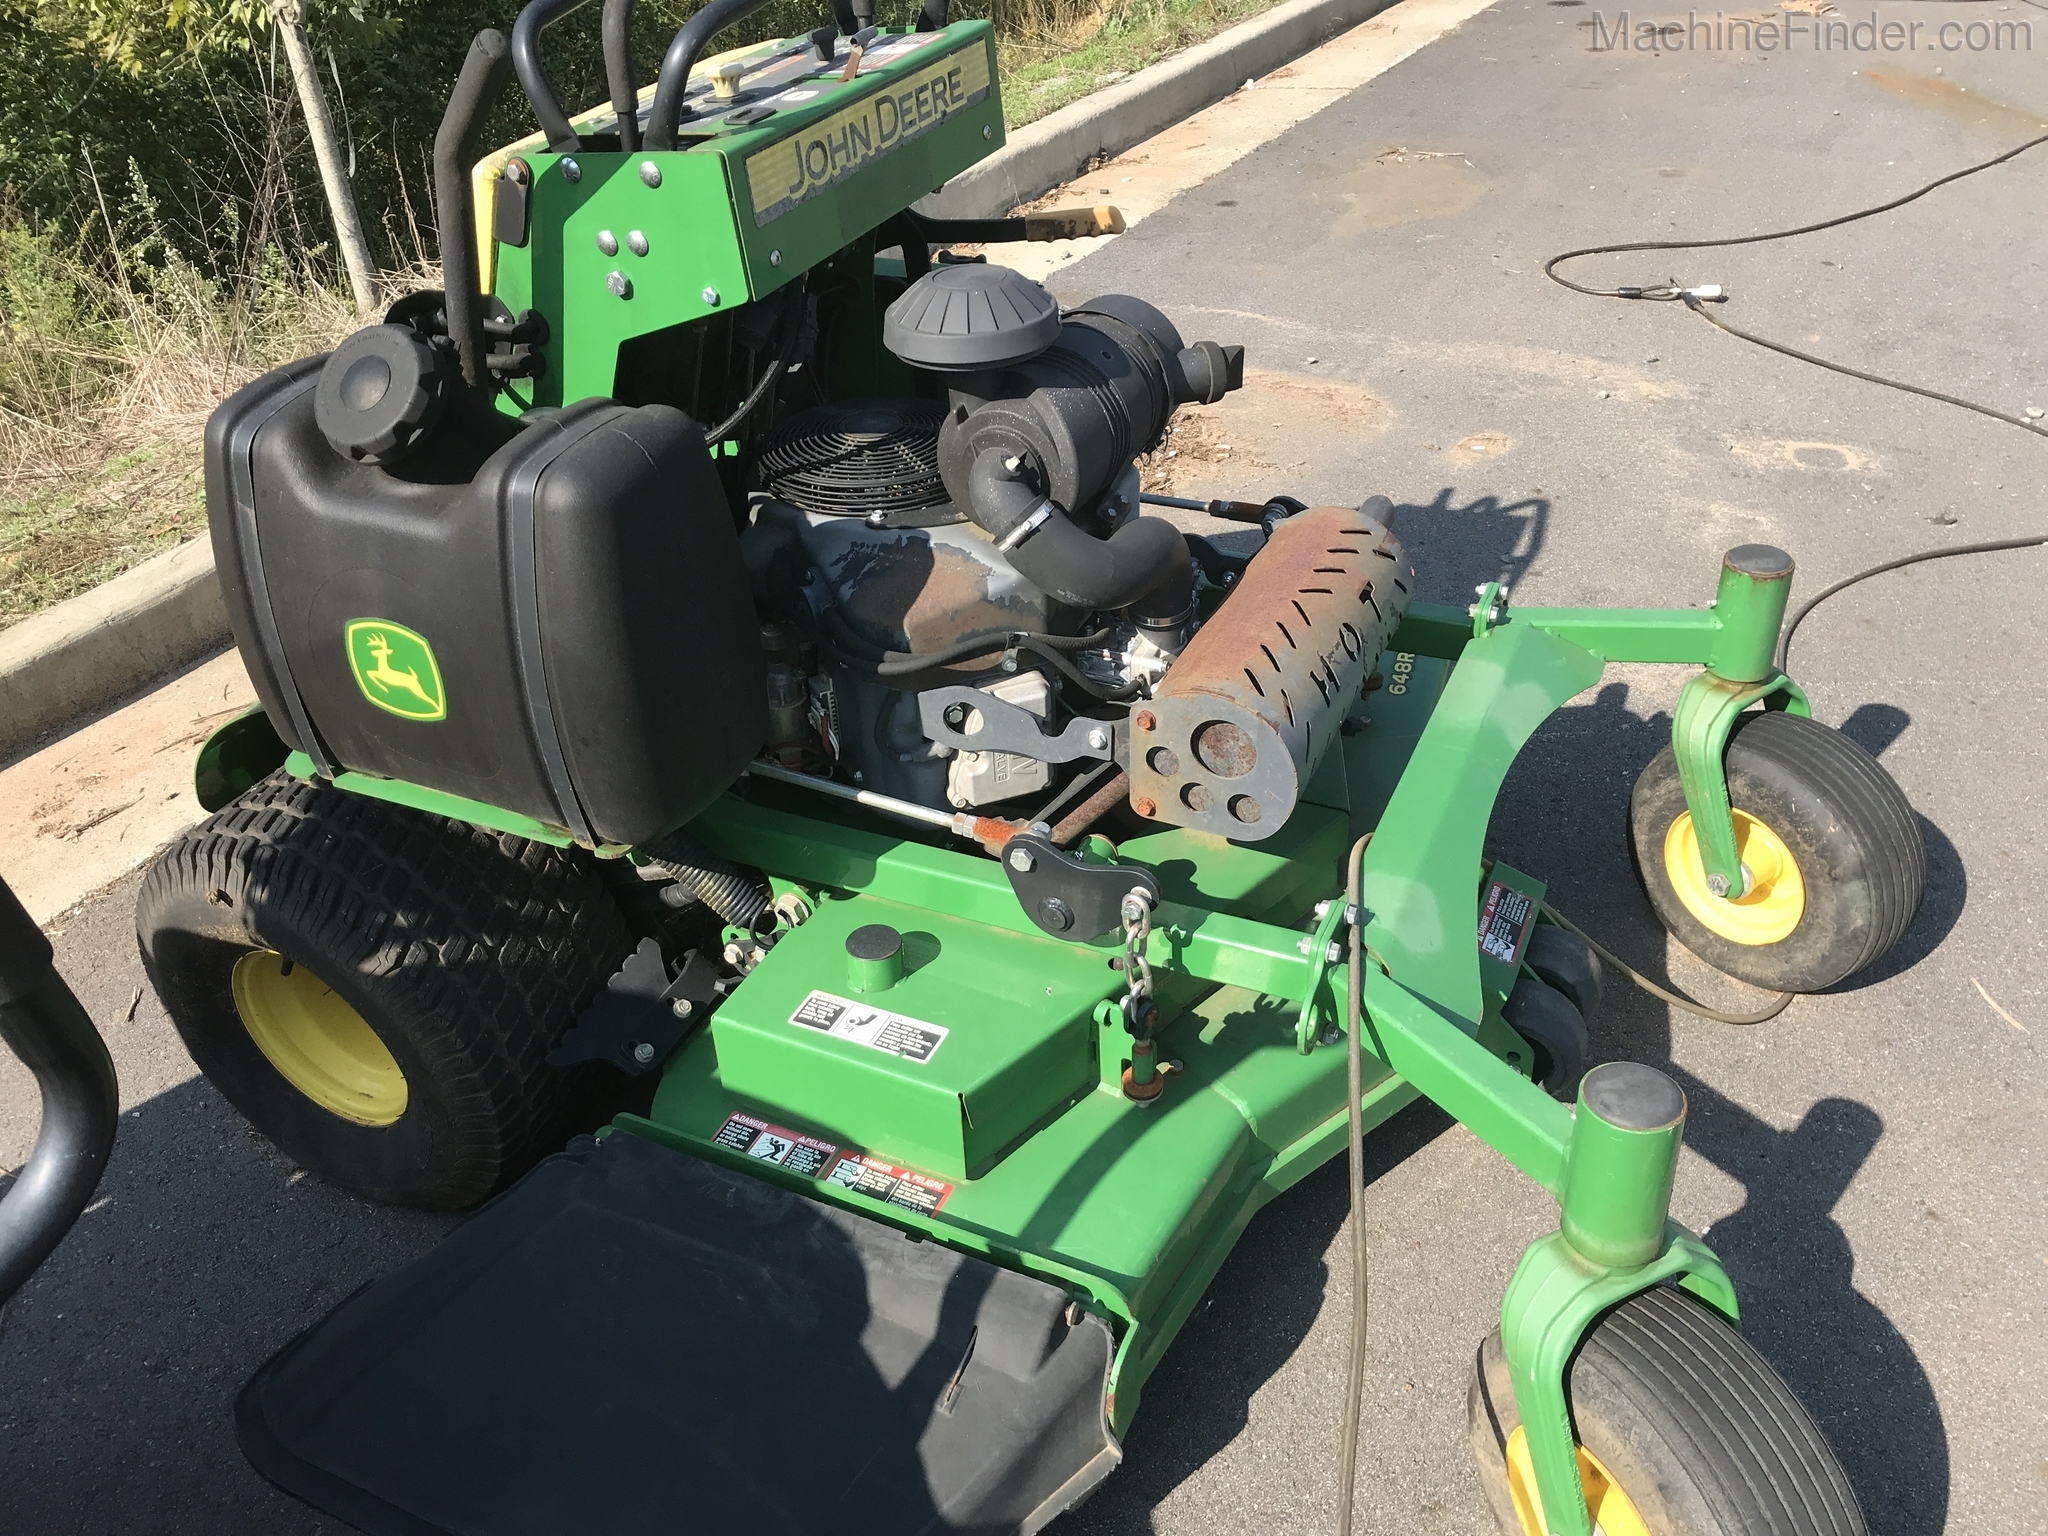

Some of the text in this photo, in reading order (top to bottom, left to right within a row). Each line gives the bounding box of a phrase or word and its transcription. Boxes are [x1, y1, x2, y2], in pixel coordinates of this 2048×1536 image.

[788, 67, 965, 195] JOHN DEERE
[1388, 652, 1416, 695] 648R
[739, 1115, 769, 1129] DANGER
[804, 1137, 836, 1152] PELIGRO
[862, 1157, 894, 1172] DANGER
[911, 1174, 946, 1190] PELIGRO
